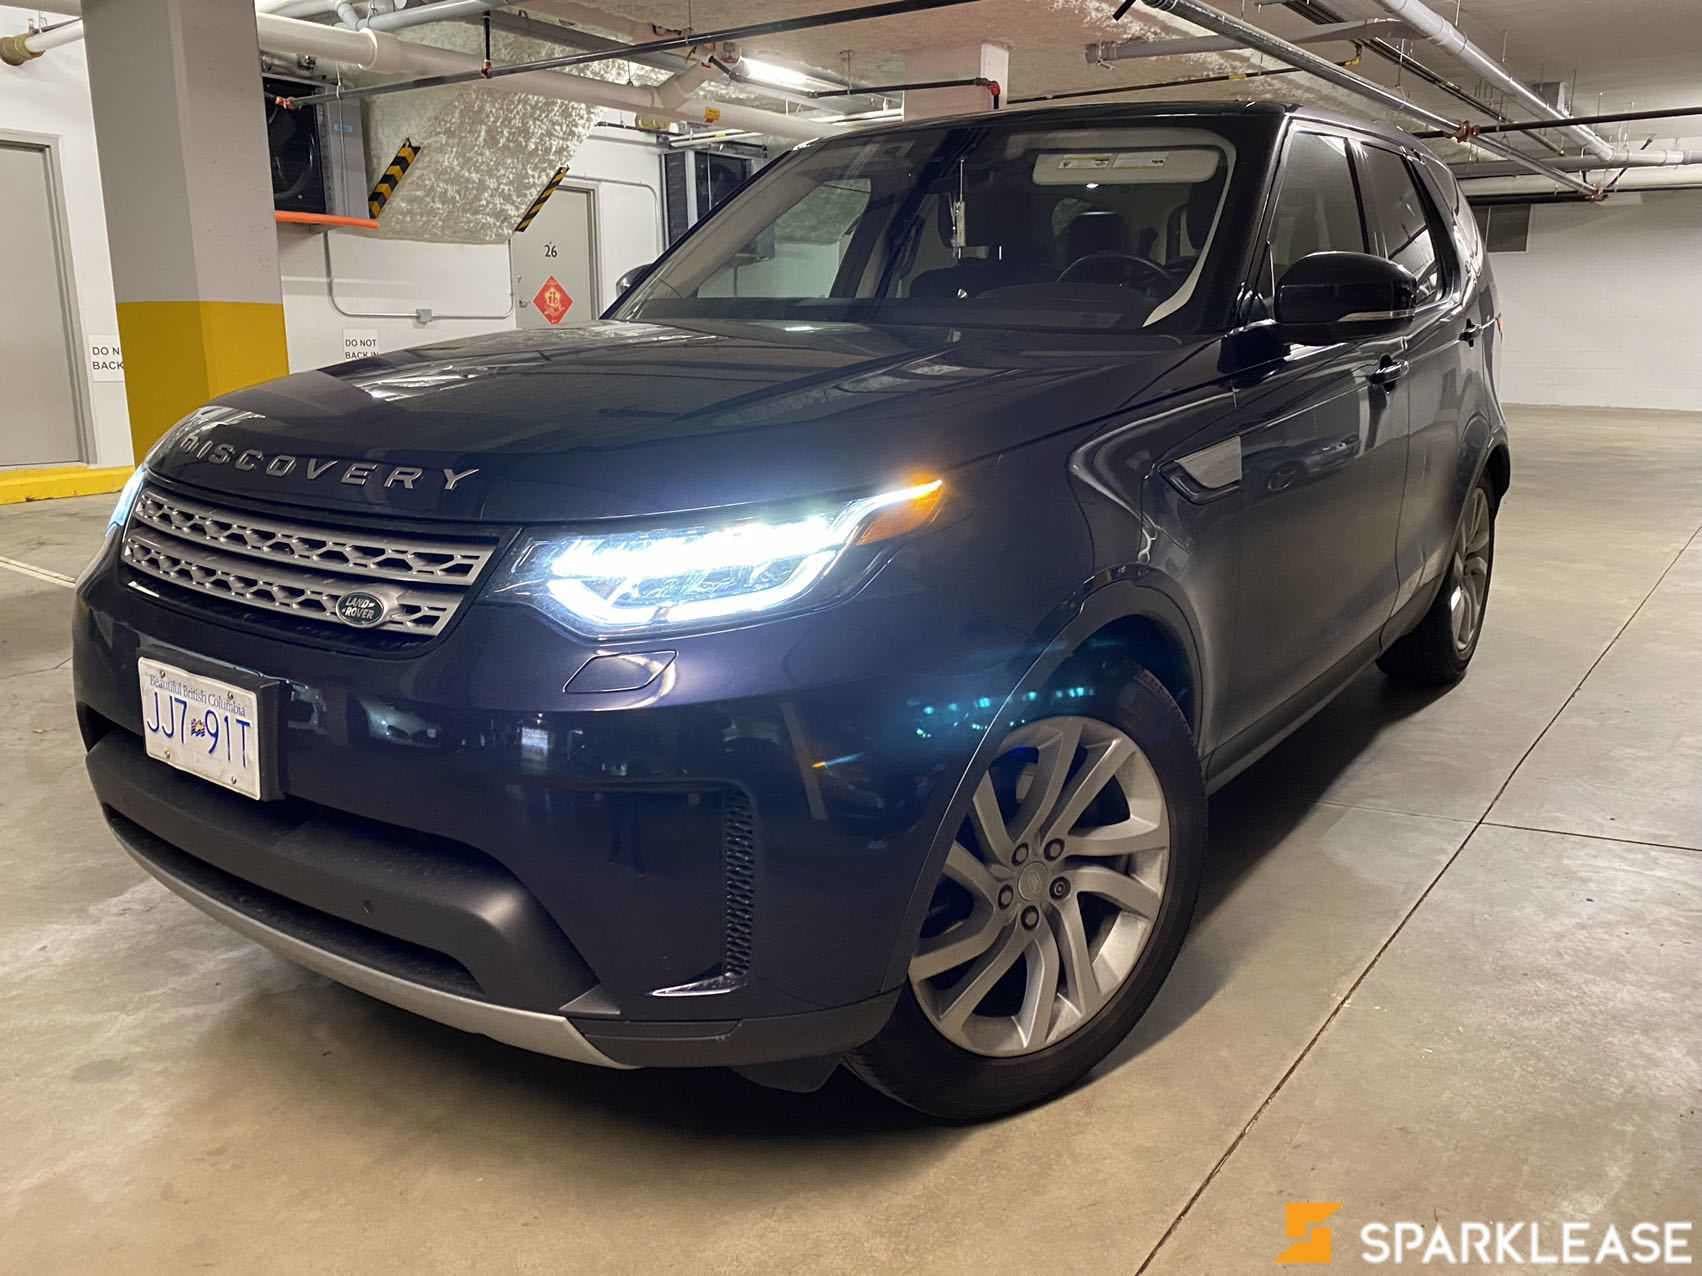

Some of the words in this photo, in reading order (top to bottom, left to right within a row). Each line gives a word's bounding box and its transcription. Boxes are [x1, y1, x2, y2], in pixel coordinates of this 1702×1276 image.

[544, 244, 558, 258] 26
[345, 338, 358, 347] DO
[359, 338, 376, 347] NOT
[92, 346, 109, 356] DO
[92, 361, 125, 370] BACK
[179, 434, 480, 490] DISCOVERY
[150, 674, 182, 696] Beautiful
[183, 685, 207, 704] British
[207, 693, 246, 717] Columbia
